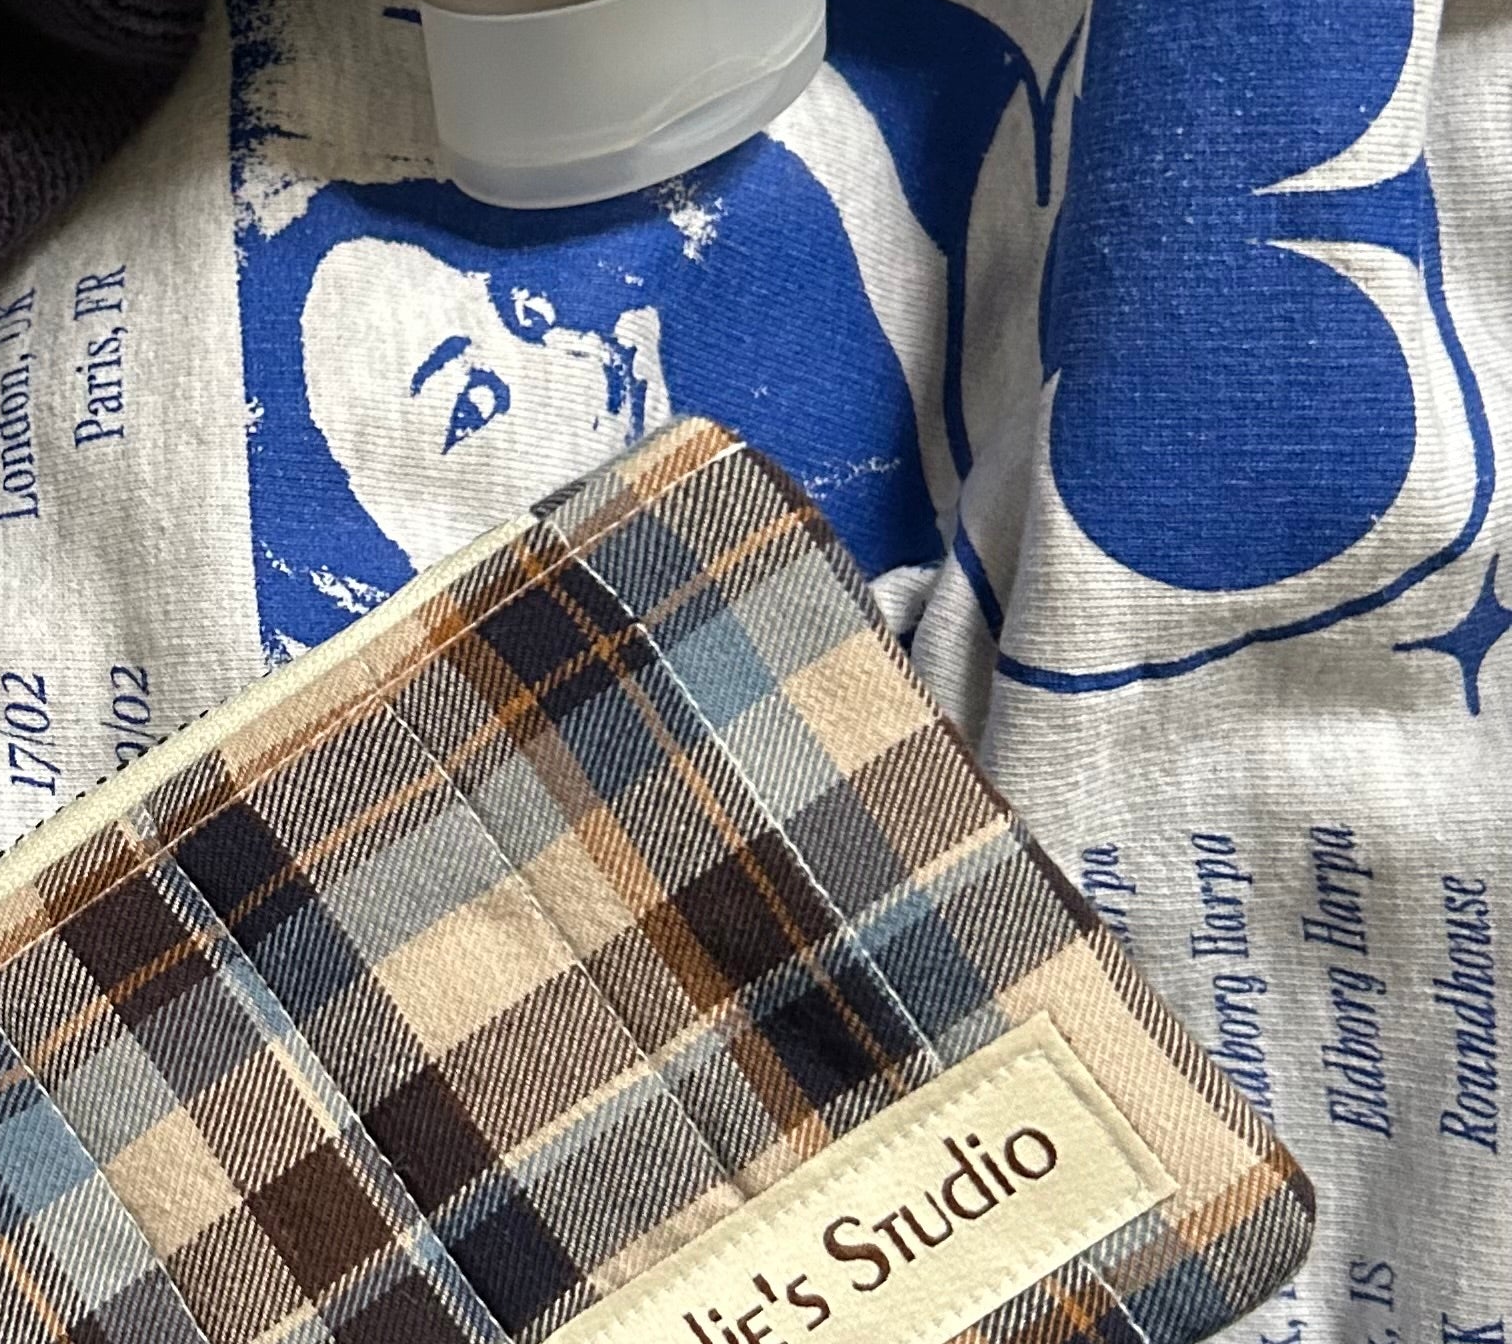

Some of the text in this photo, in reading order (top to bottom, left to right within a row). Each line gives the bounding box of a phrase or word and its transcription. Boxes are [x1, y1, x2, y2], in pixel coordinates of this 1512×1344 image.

[74, 264, 126, 321] FR
[74, 323, 128, 447] Paris,
[1191, 833, 1253, 959] Harpa
[1302, 824, 1393, 1140] Eldborg Harpa
[1433, 875, 1497, 1155] Roundhouse
[1350, 1260, 1397, 1312] IS
